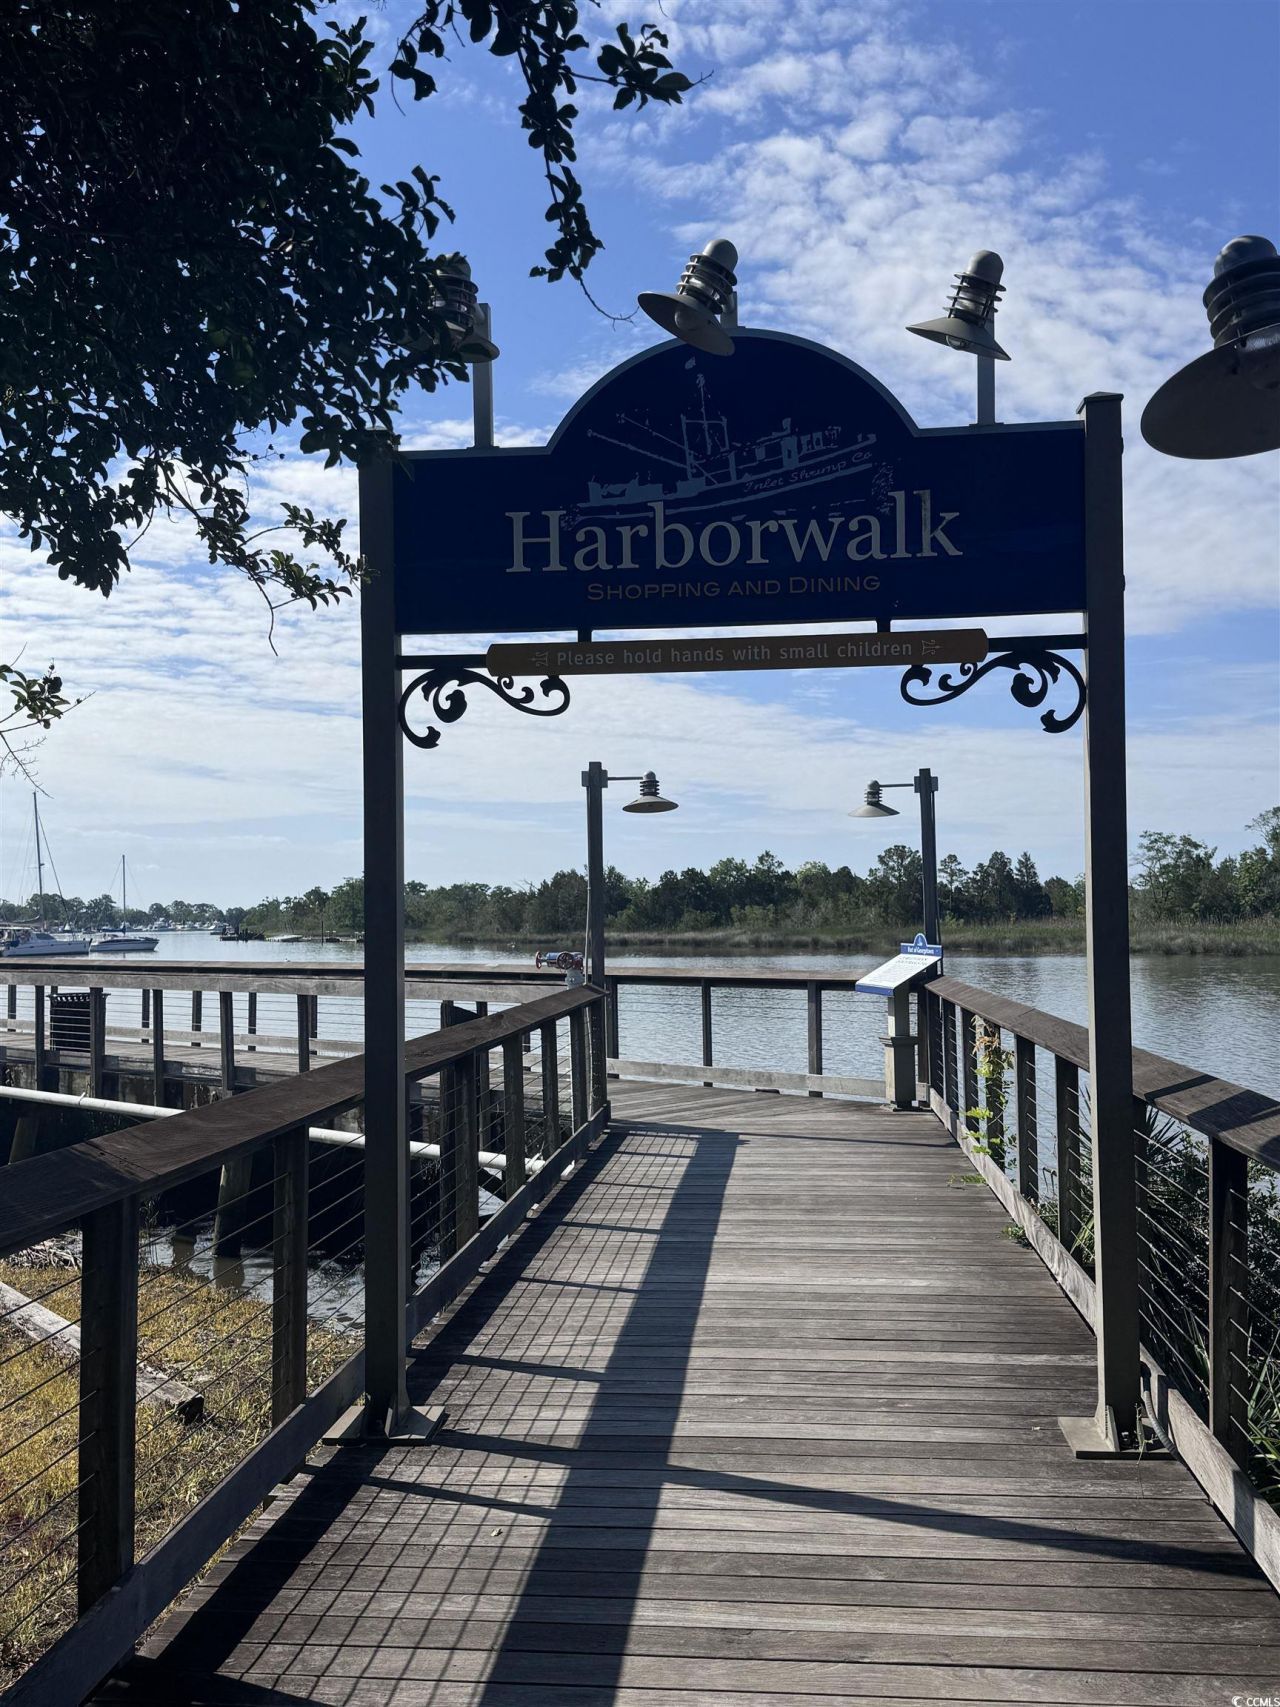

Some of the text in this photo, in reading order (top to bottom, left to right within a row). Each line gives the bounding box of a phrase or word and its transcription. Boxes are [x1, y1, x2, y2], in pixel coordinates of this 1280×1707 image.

[743, 477, 784, 492] Inlet
[505, 489, 963, 572] Harborwalk
[587, 575, 881, 600] SHOPPING AND DINING
[557, 642, 913, 666] Please hold hands with small children
